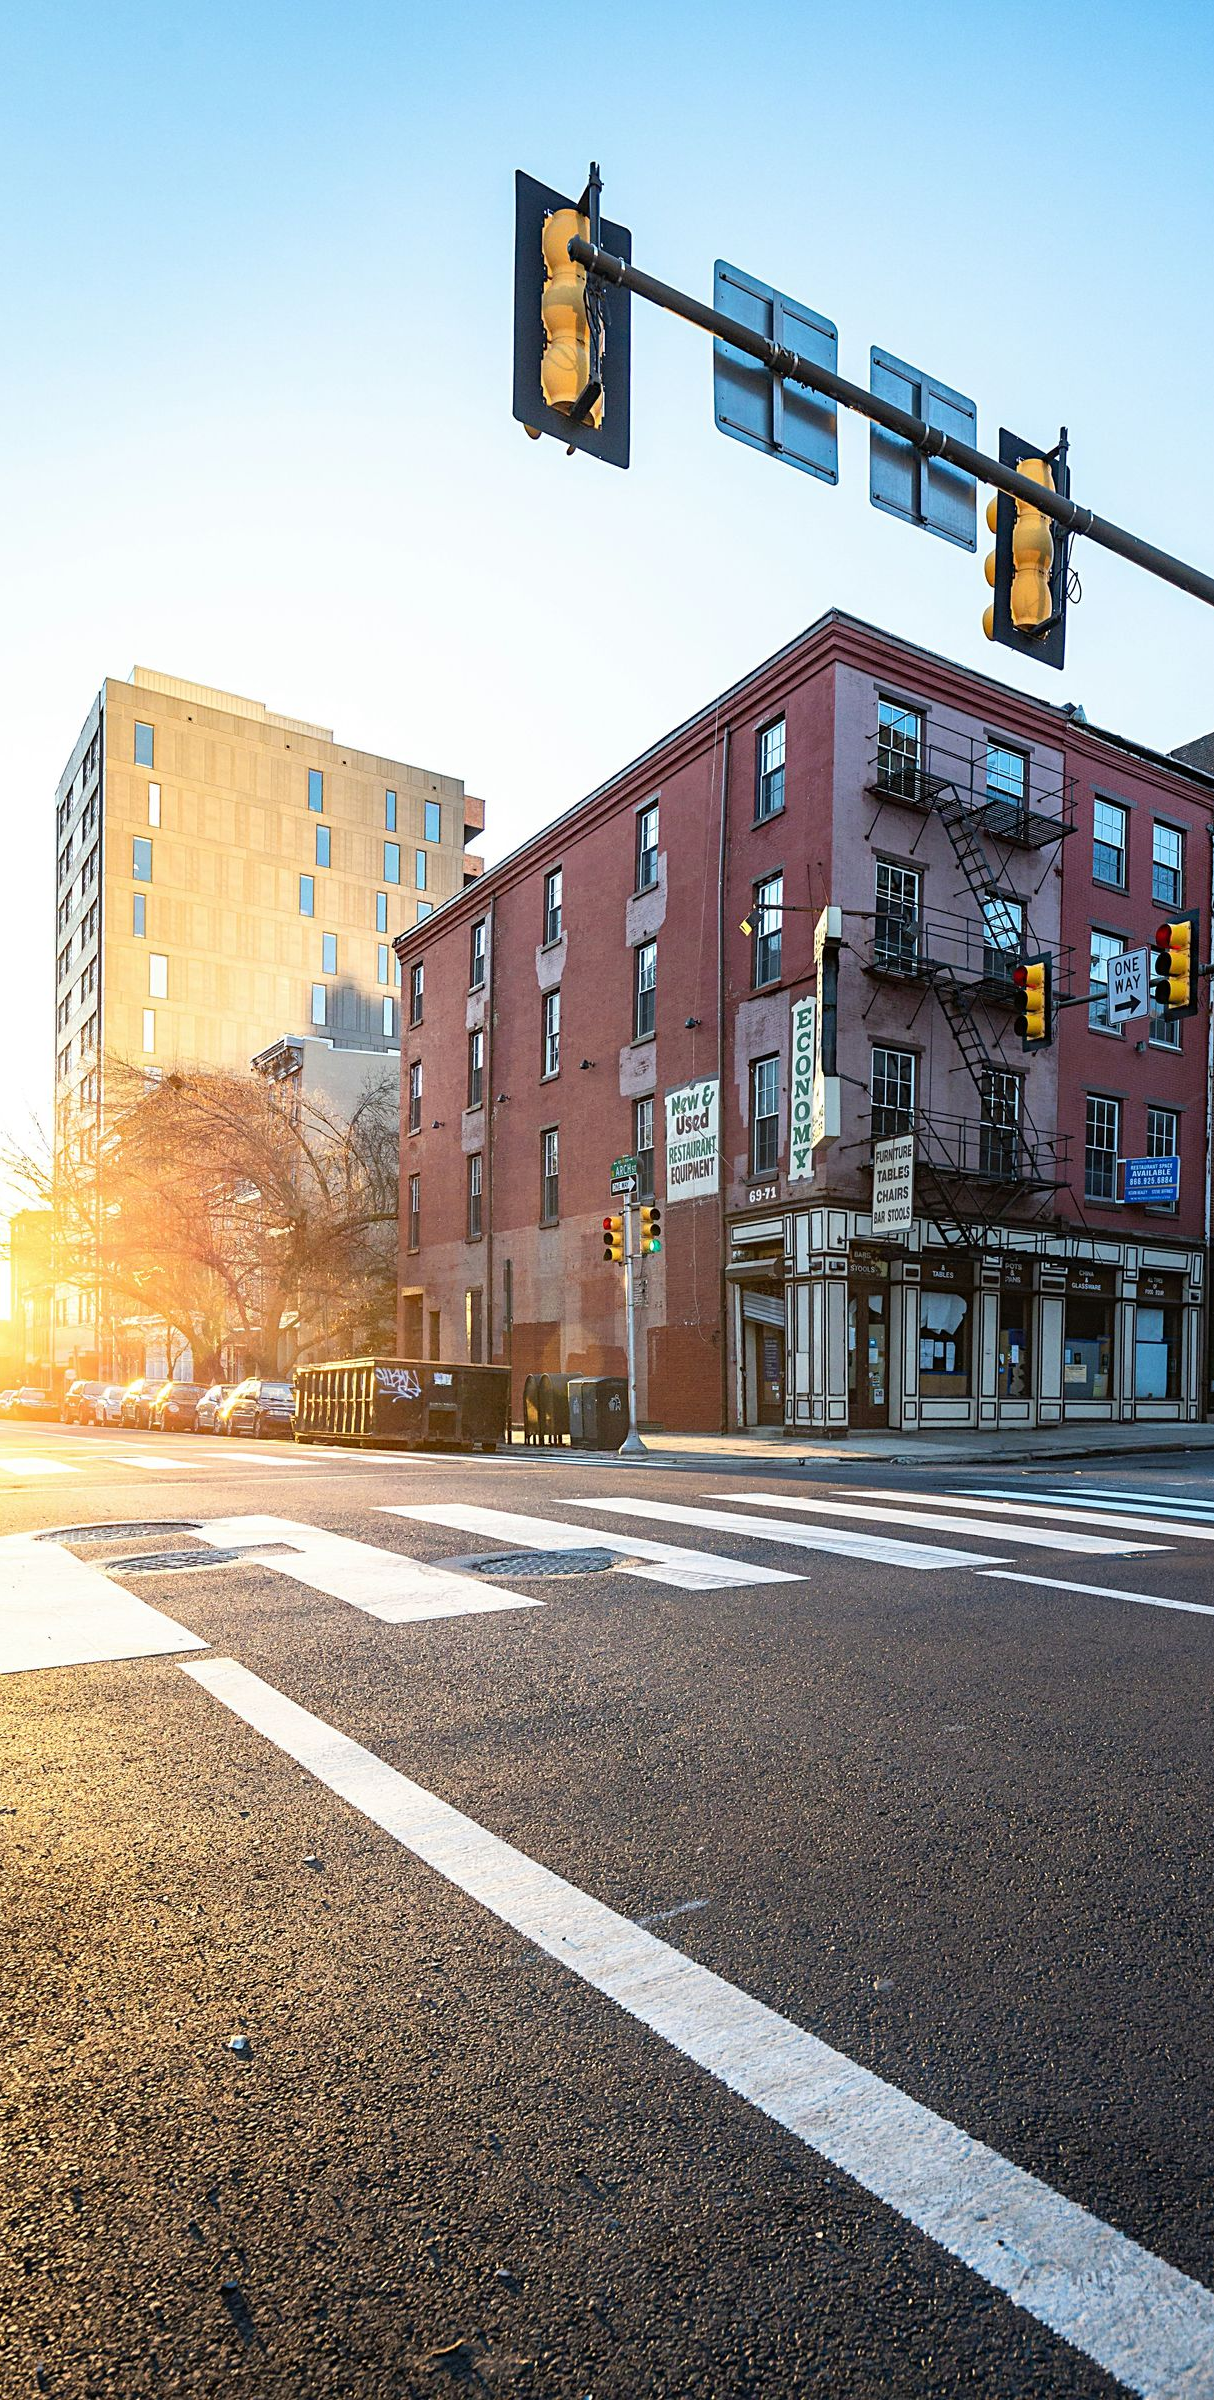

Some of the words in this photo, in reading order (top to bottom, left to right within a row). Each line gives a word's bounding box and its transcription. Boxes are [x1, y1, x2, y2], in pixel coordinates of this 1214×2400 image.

[1115, 957, 1139, 976] ONE
[1115, 974, 1141, 994] WAY
[702, 1085, 714, 1106] &
[793, 1007, 812, 1169] ECONOMY
[676, 1107, 709, 1135] Used
[669, 1135, 716, 1165] RESTAURANT
[876, 1144, 912, 1164] FURNITURE
[615, 1164, 631, 1177] ARCH
[671, 1157, 715, 1185] EQUIPMENT
[877, 1165, 910, 1183] TABLES
[1132, 1169, 1171, 1177] AVAILABLE
[613, 1182, 621, 1191] ONE
[621, 1181, 629, 1189] WAY
[749, 1186, 776, 1203] 69-71
[877, 1186, 909, 1204] CHAIRS
[874, 1210, 885, 1224] BAR
[887, 1206, 910, 1222] STOOLS
[854, 1251, 871, 1259] BARS
[932, 1270, 954, 1279] TABLES
[1005, 1262, 1022, 1271] POTS
[1079, 1269, 1094, 1277] CHINA
[1071, 1282, 1101, 1291] GLASSWARE
